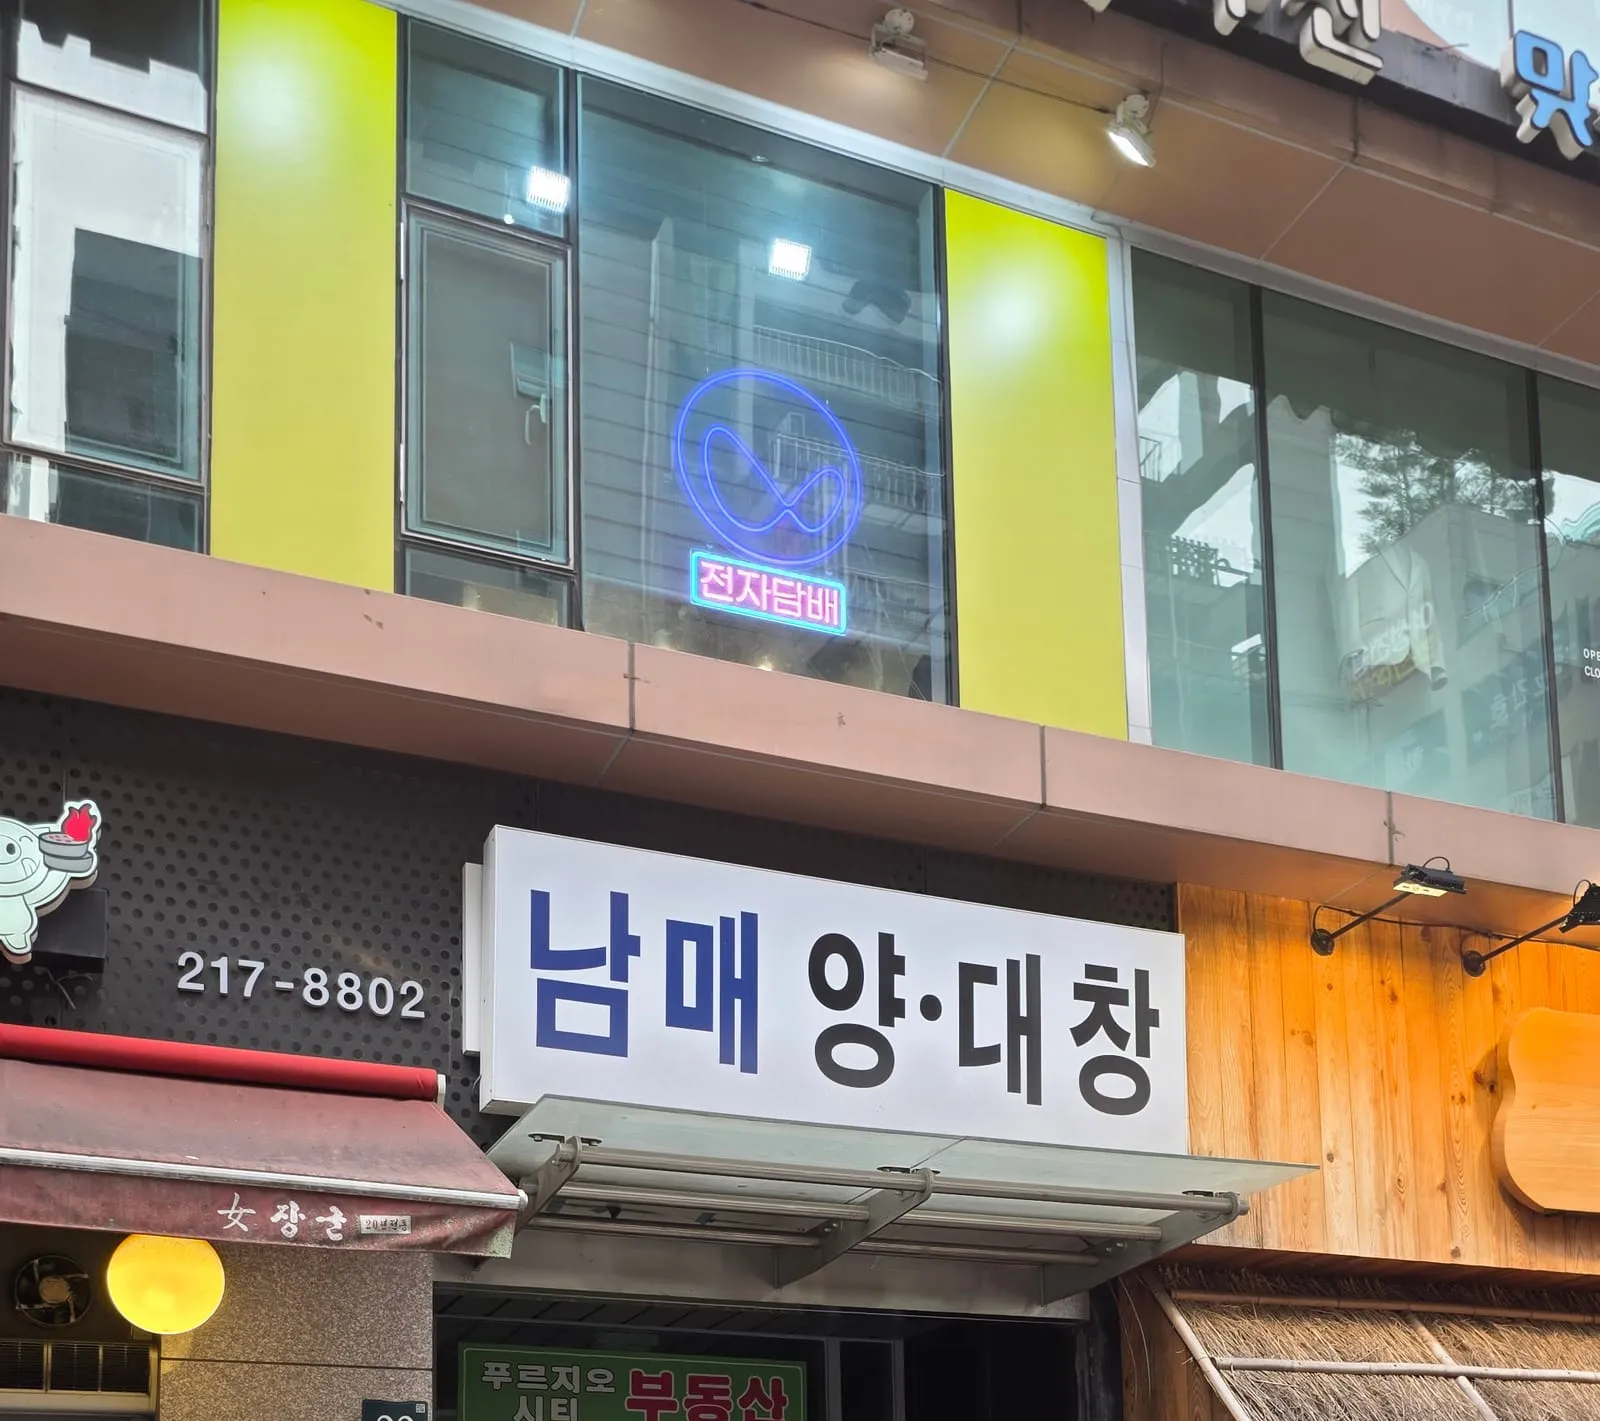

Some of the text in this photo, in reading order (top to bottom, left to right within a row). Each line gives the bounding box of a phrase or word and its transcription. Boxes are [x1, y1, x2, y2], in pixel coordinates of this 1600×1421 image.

[700, 561, 838, 626] 전자담배
[177, 950, 426, 1020] 217-8802
[530, 889, 759, 1074] 남매
[481, 1360, 616, 1395] 푸르지오
